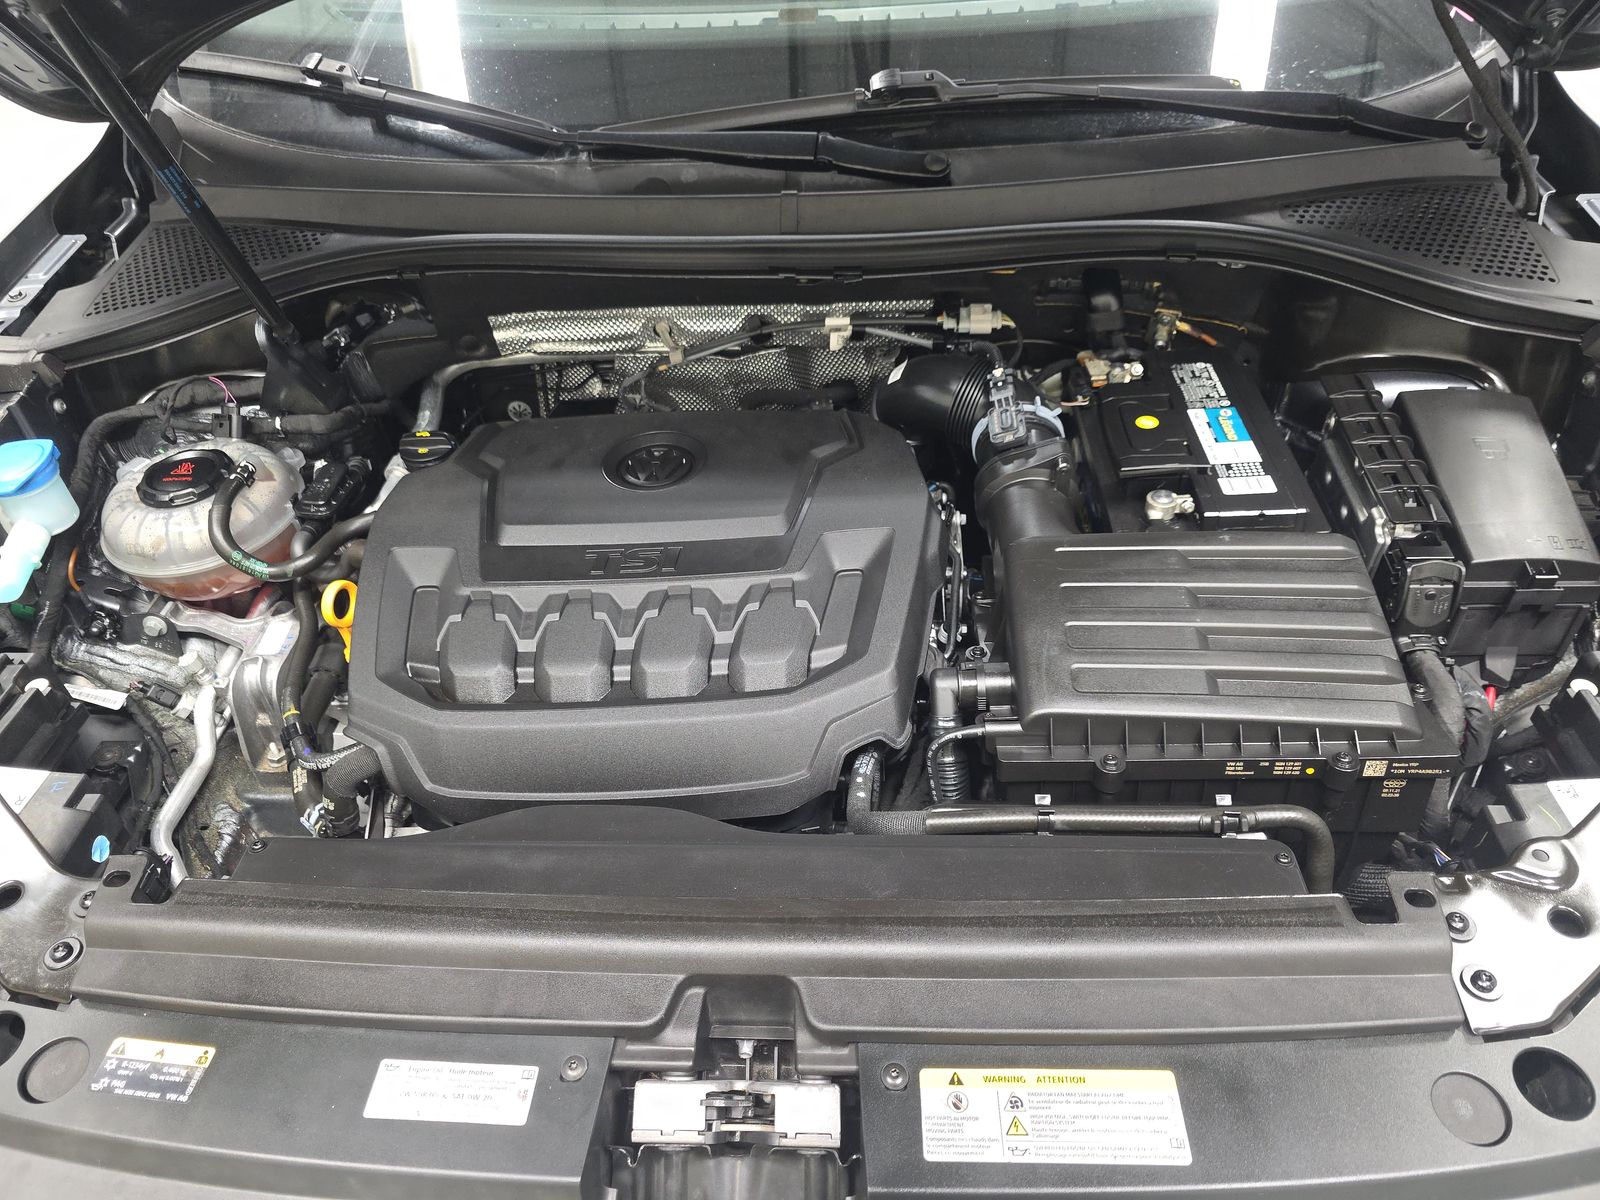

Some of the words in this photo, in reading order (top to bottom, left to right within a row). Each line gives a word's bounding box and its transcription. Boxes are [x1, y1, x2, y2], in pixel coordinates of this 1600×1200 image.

[585, 546, 684, 575] TSI
[983, 1075, 1026, 1083] WARNING
[1036, 1076, 1086, 1084] ATTENTION
